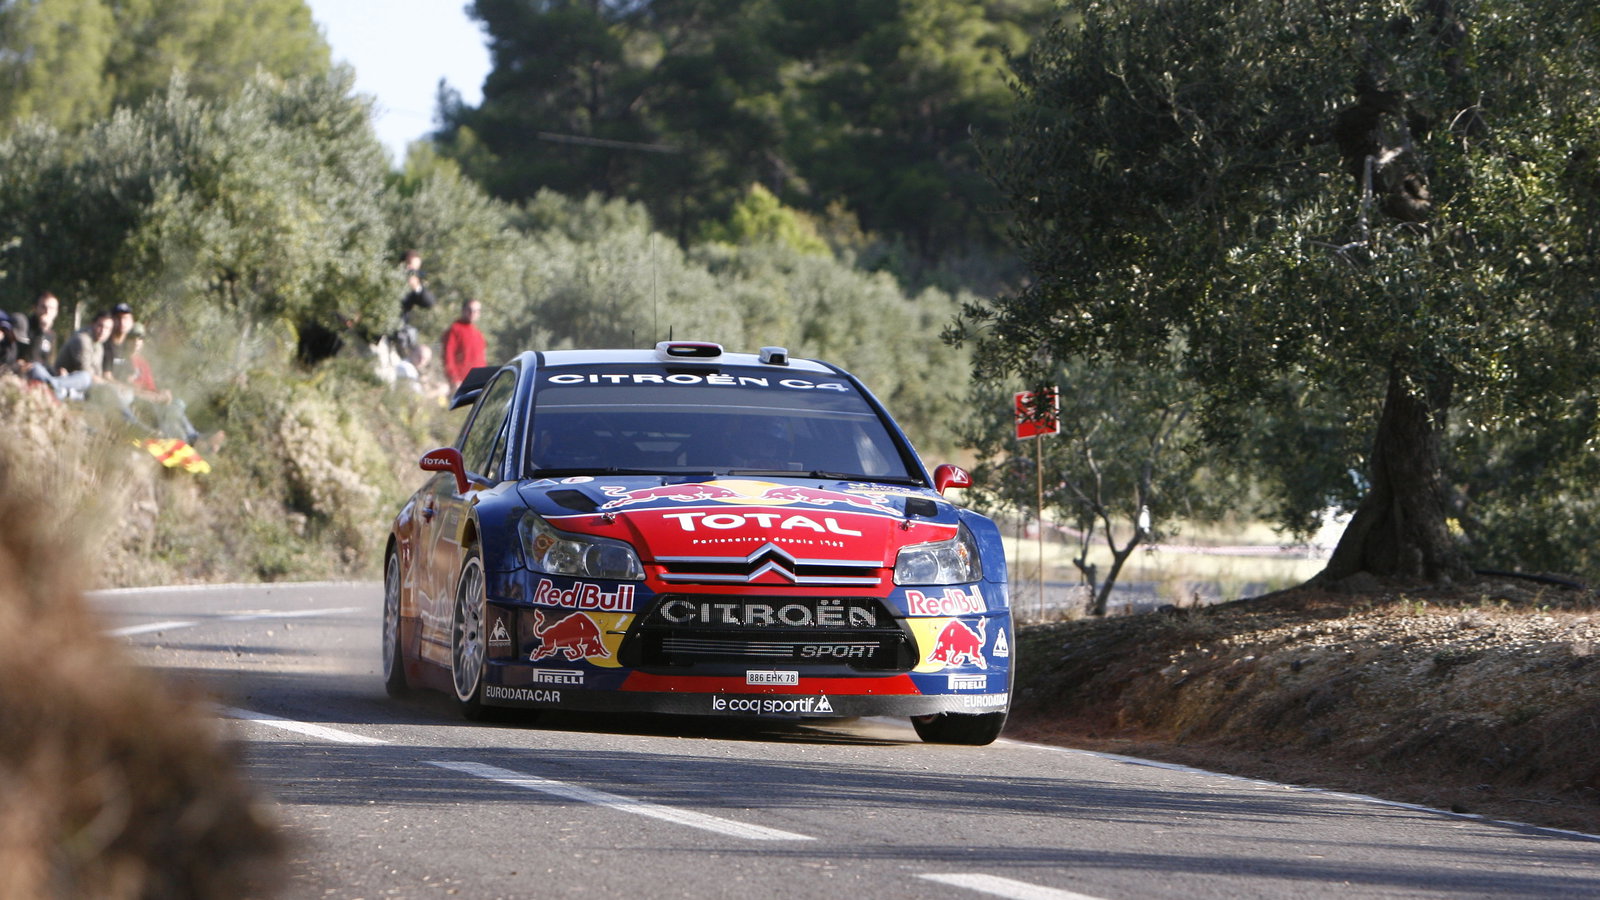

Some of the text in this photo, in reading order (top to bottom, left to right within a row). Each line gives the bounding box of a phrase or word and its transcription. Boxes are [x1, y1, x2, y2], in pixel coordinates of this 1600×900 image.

[548, 373, 849, 392] CITROËN C4
[423, 457, 452, 465] TOTAL
[662, 512, 863, 537] TOTAL
[660, 599, 877, 628] CITROËN
[799, 645, 881, 658] SPORT
[532, 668, 585, 685] PIRELLI
[749, 673, 796, 683] 886 EHK 78
[947, 674, 987, 690] PIRELLI
[486, 685, 561, 703] EURODATACAR
[712, 695, 815, 715] le coq sportif
